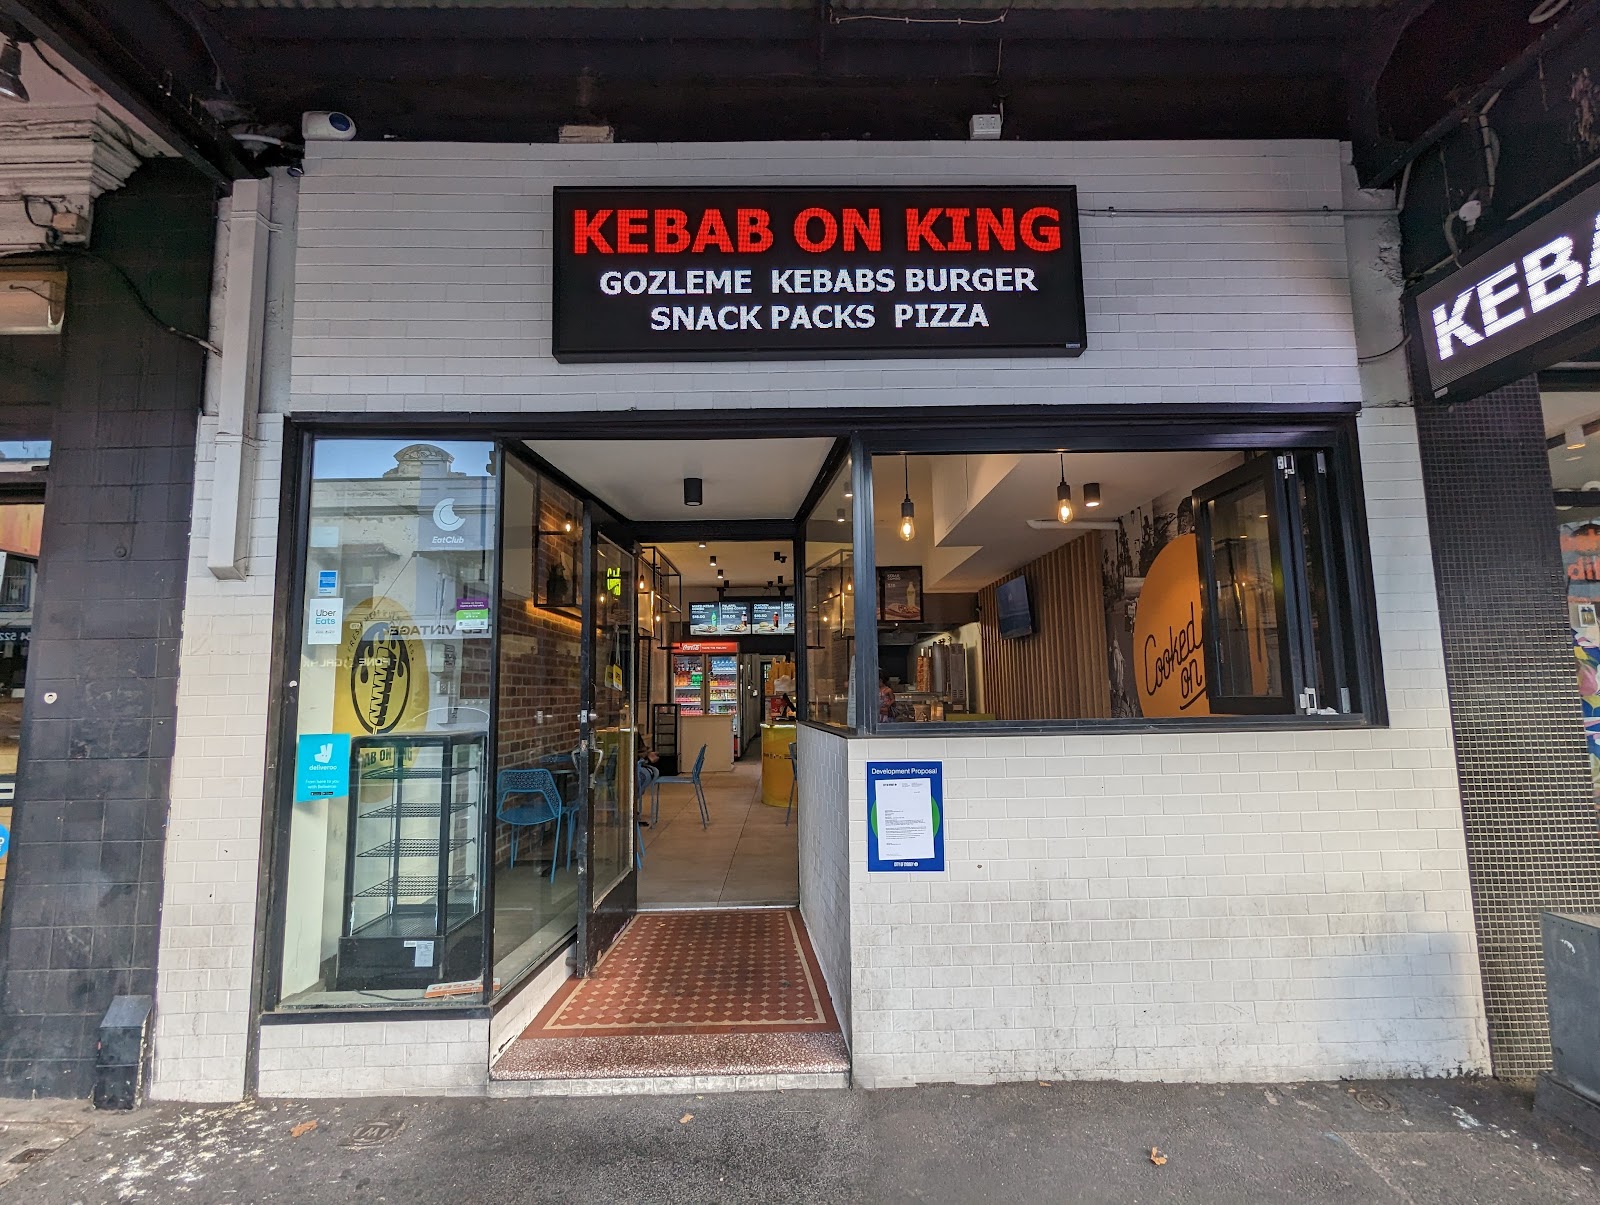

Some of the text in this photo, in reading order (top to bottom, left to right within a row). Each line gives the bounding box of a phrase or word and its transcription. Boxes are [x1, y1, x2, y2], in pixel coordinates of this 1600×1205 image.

[574, 207, 1061, 254] KEBAB ON KING
[599, 267, 1039, 295] GOZLEME KEBABS BURGER
[651, 303, 990, 331] SNACK PACKS PIZZA
[431, 536, 465, 544] EatClub
[316, 609, 336, 617] Uber
[1145, 601, 1203, 696] Cooked
[1181, 659, 1202, 699] on
